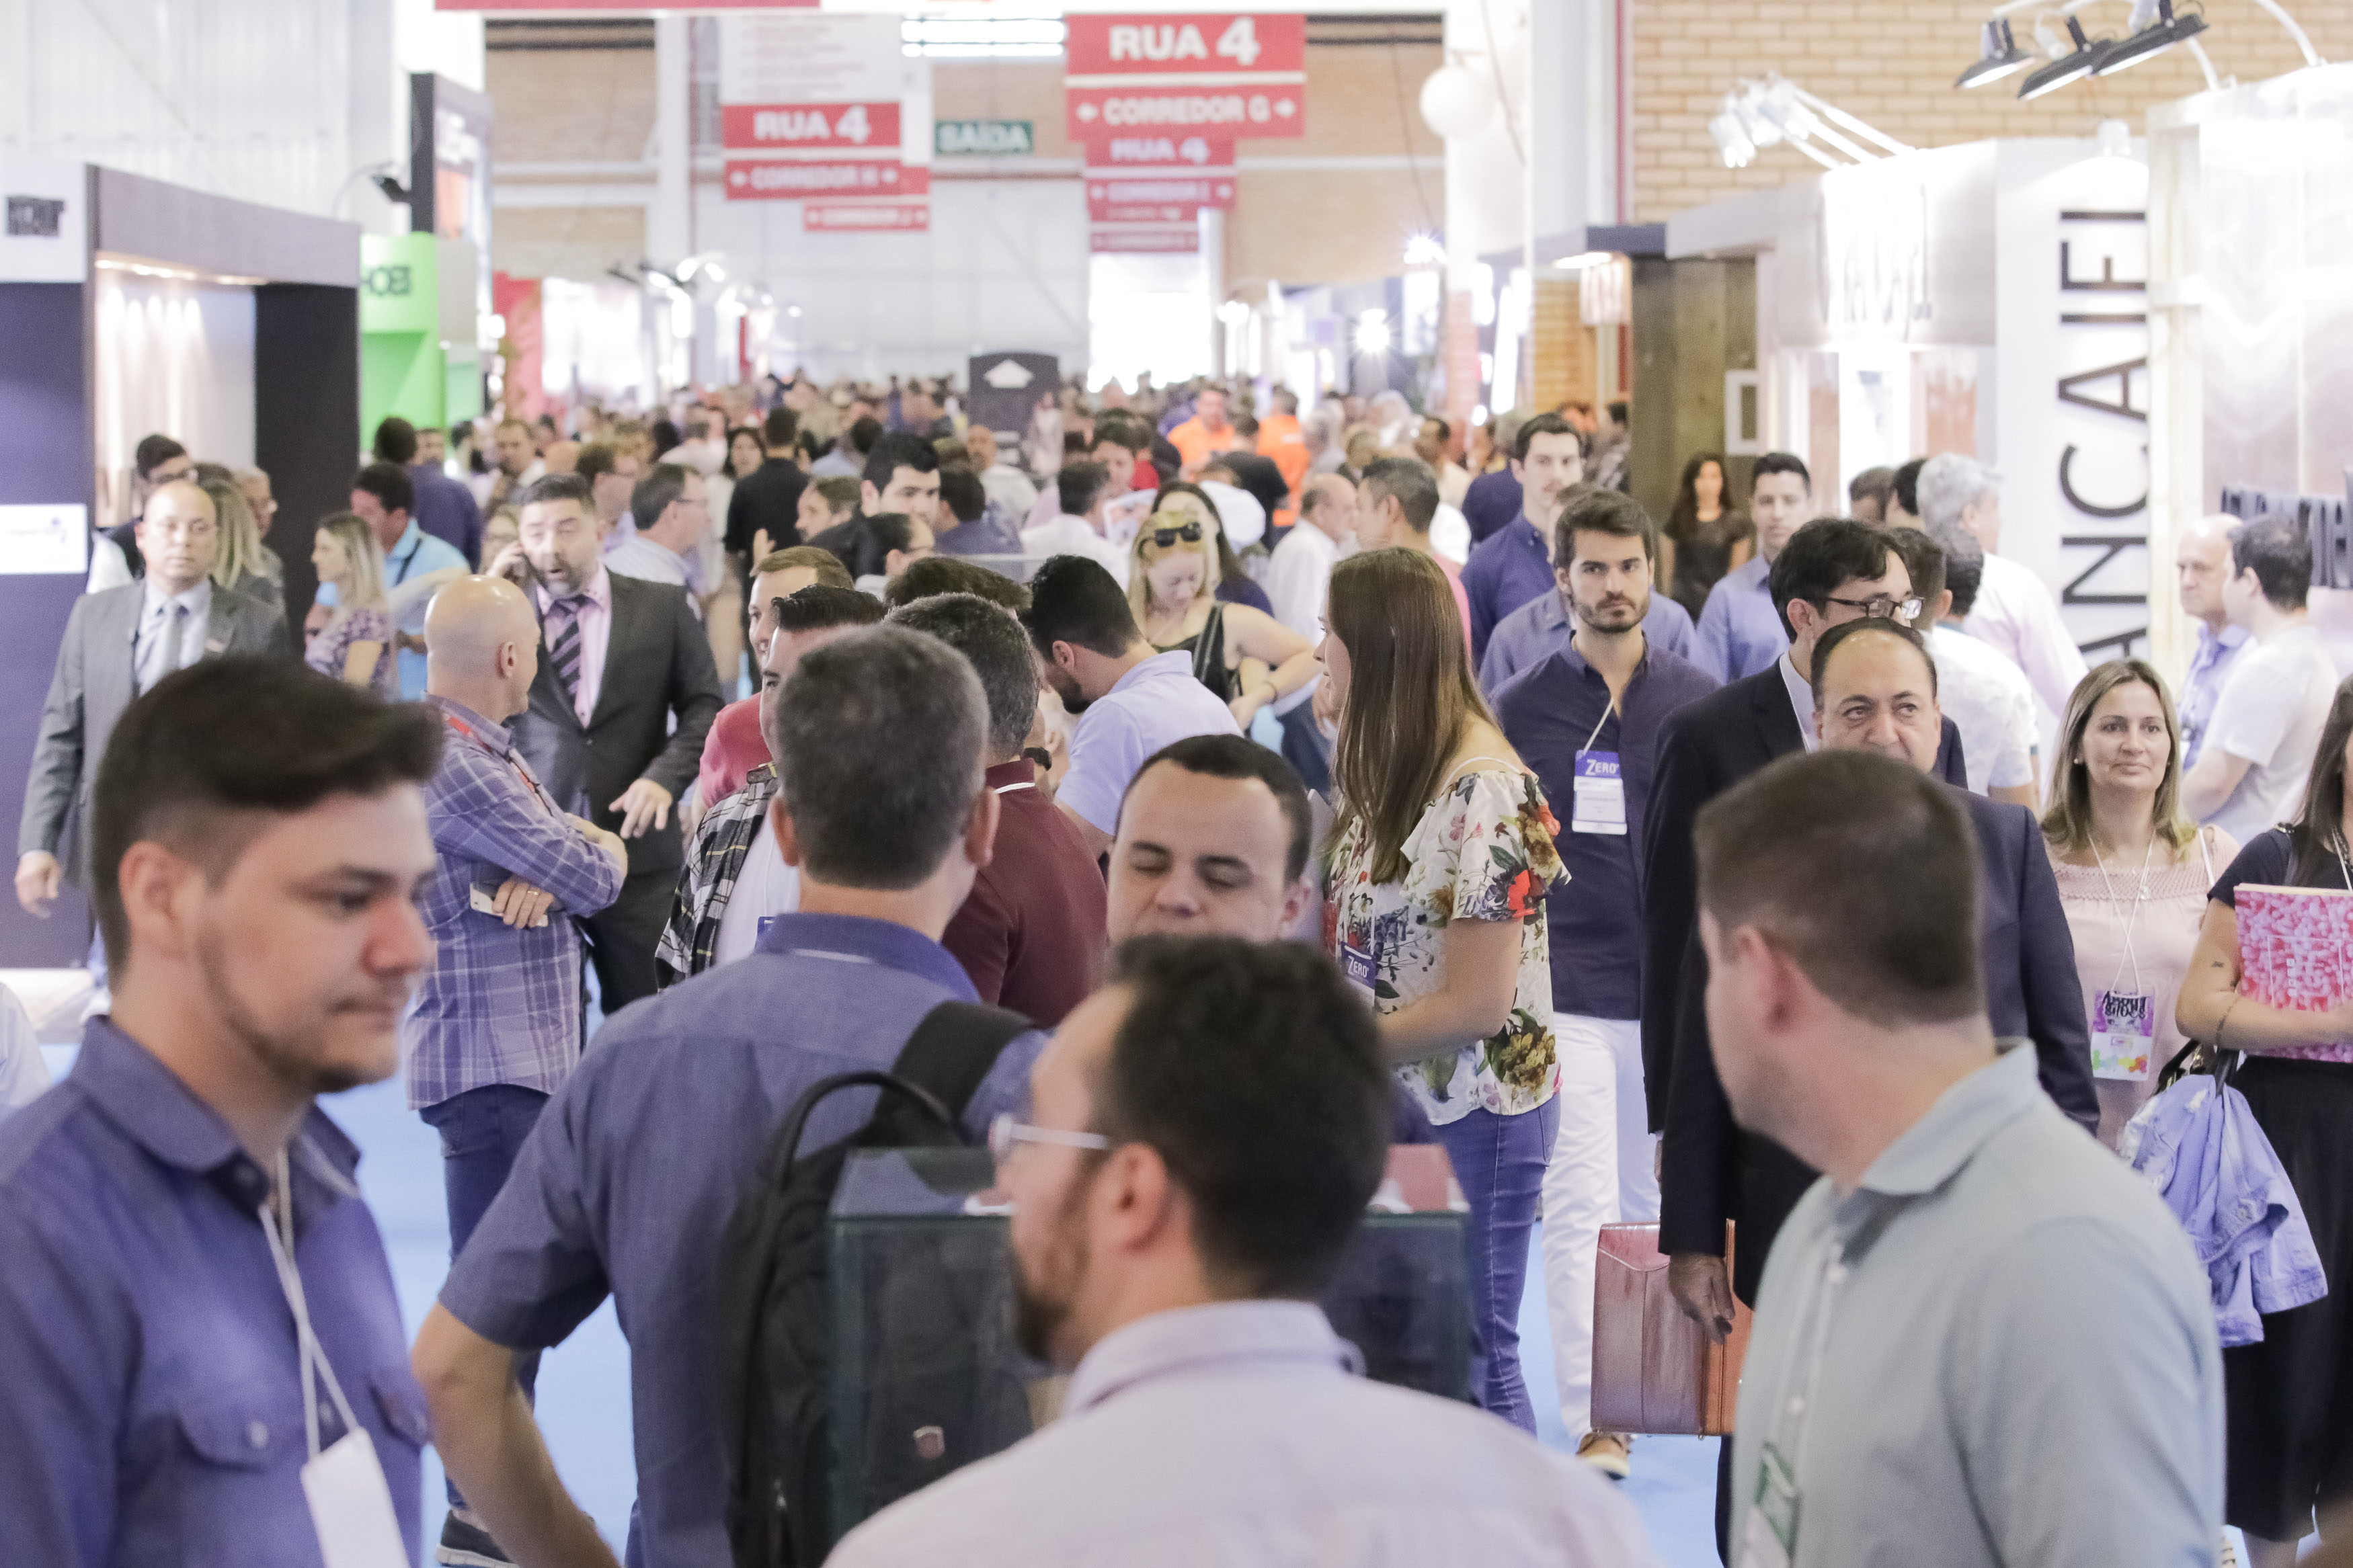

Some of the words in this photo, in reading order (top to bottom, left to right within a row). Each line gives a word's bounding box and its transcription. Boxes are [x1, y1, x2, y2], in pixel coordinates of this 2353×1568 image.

[1109, 24, 1208, 61] RUA
[1216, 15, 1261, 66] 4
[754, 110, 831, 140] RUA
[836, 105, 871, 144] 4
[1103, 95, 1246, 126] CORREDOR
[1110, 138, 1176, 161] RUA
[1179, 136, 1211, 164] 4
